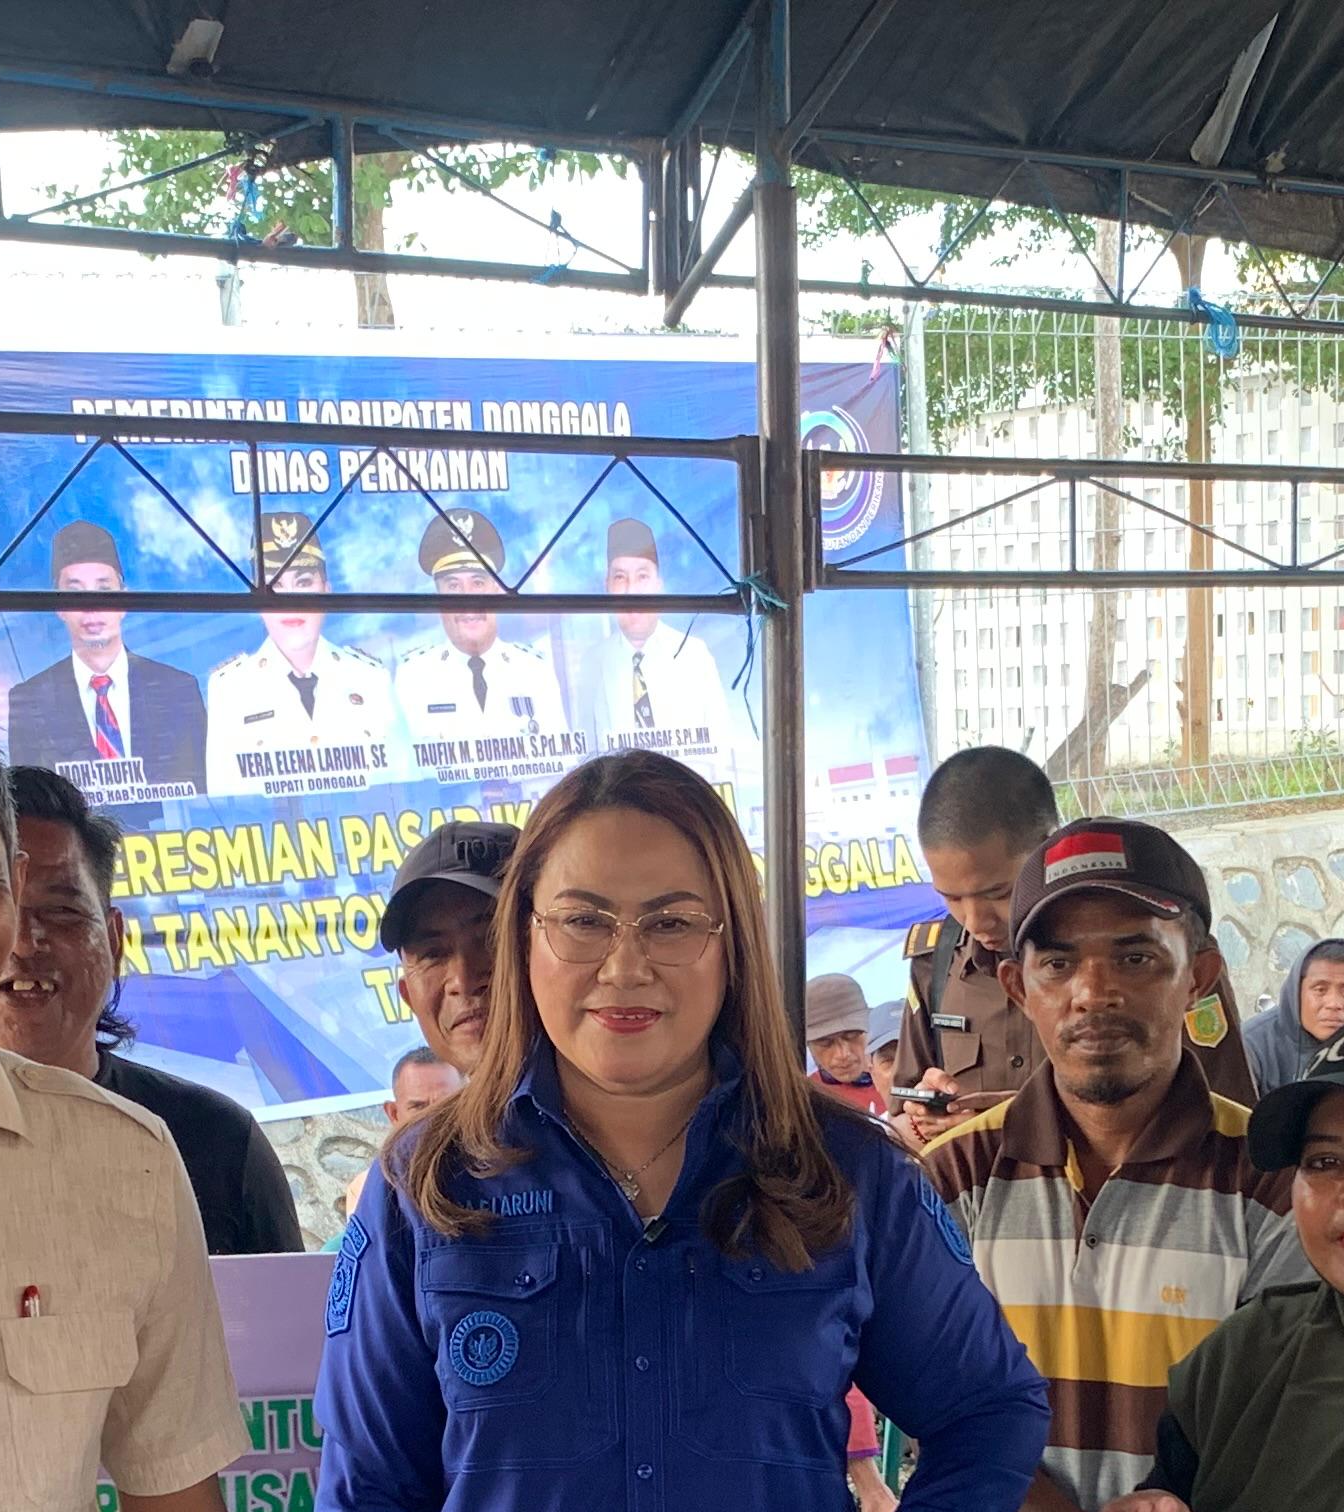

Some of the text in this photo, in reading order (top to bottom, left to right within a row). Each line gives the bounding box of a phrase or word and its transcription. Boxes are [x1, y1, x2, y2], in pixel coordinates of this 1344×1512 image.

[231, 449, 509, 494] DINAS PERIKANAN
[236, 744, 388, 778] VERA ELENA LARUNI, SE
[413, 742, 457, 767] TAUFIK
[459, 740, 474, 763] M.
[475, 736, 529, 761] BURHAN,
[94, 760, 144, 786] TAUFIK
[264, 774, 367, 794] BUPATI DONGGALA
[437, 761, 564, 782] WAKIL BUPATI DONGGALA
[137, 784, 194, 800] DONGGALA
[110, 818, 337, 898] ERESMIAN
[1047, 860, 1123, 880] INDONESIA
